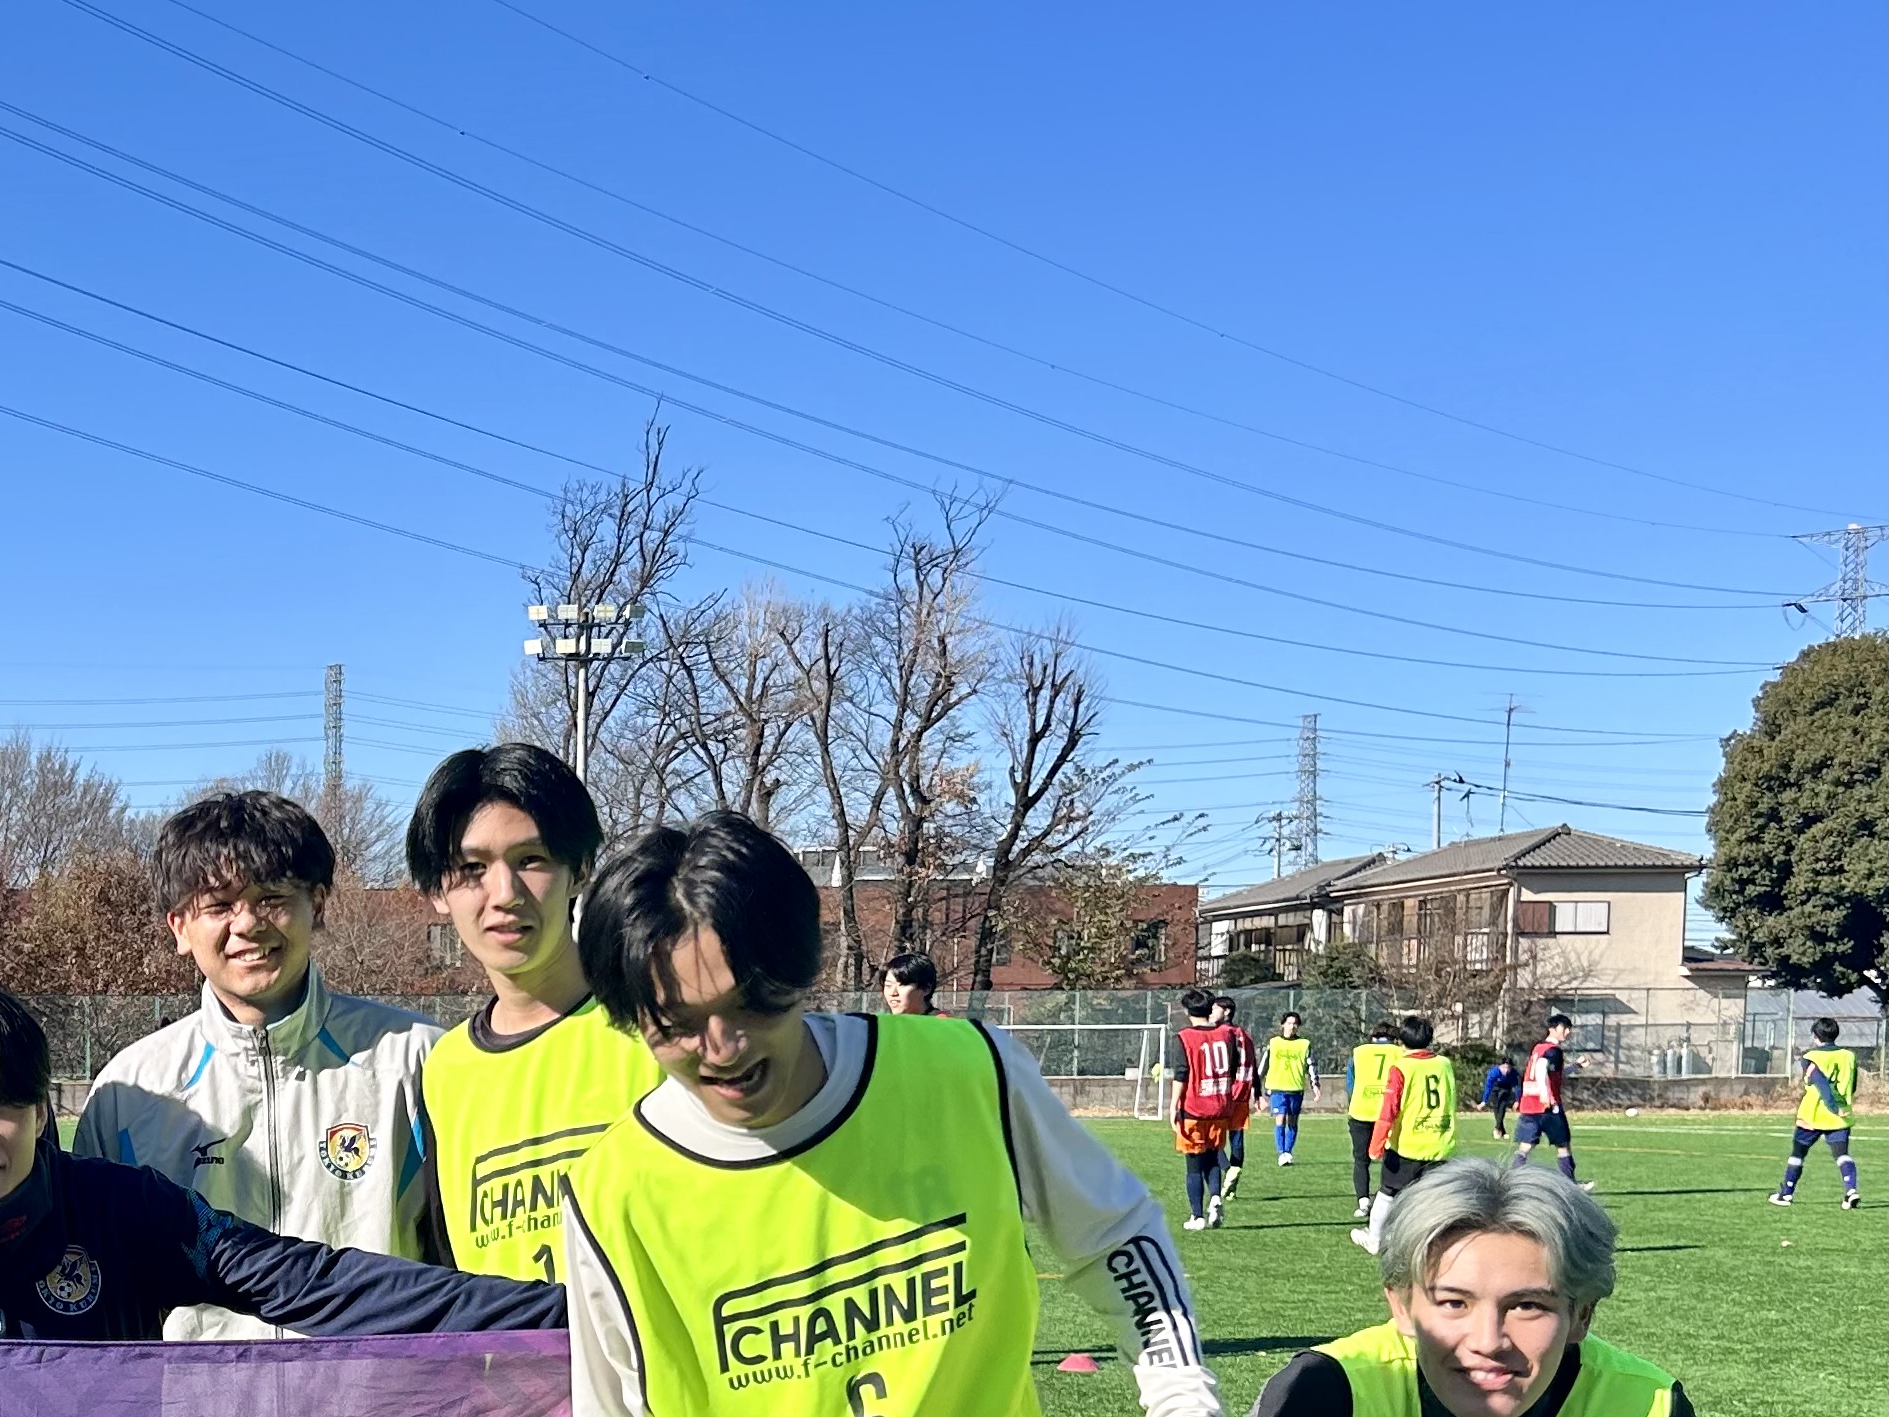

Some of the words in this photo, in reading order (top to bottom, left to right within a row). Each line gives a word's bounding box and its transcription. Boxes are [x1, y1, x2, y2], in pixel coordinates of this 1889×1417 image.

[1200, 1041, 1228, 1077] 10
[1374, 1054, 1386, 1080] 7
[728, 1301, 976, 1391] www.f-channel.net
